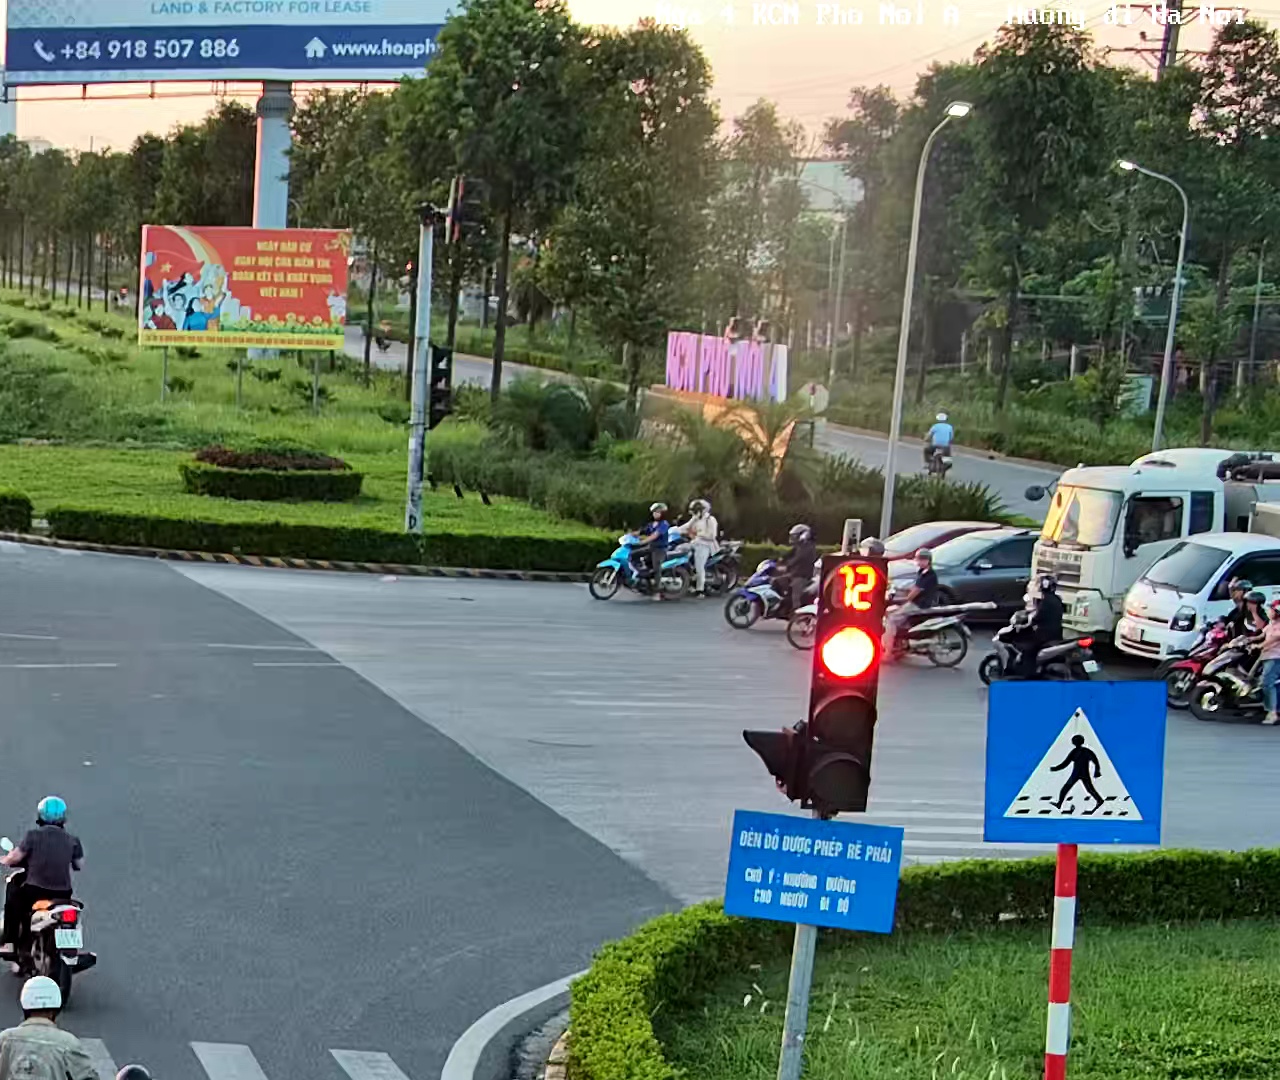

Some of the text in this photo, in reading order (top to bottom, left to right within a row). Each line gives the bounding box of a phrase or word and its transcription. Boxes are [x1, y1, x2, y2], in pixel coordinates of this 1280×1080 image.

[150, 0, 372, 14] LAND & FACTORY FOR LEASE
[60, 40, 101, 59] +84
[108, 40, 147, 59] 918
[153, 39, 193, 58] 507
[200, 38, 240, 58] 886
[813, 836, 843, 857] PHÉP
[847, 840, 862, 861] RẼ
[865, 841, 892, 864] PHẢI
